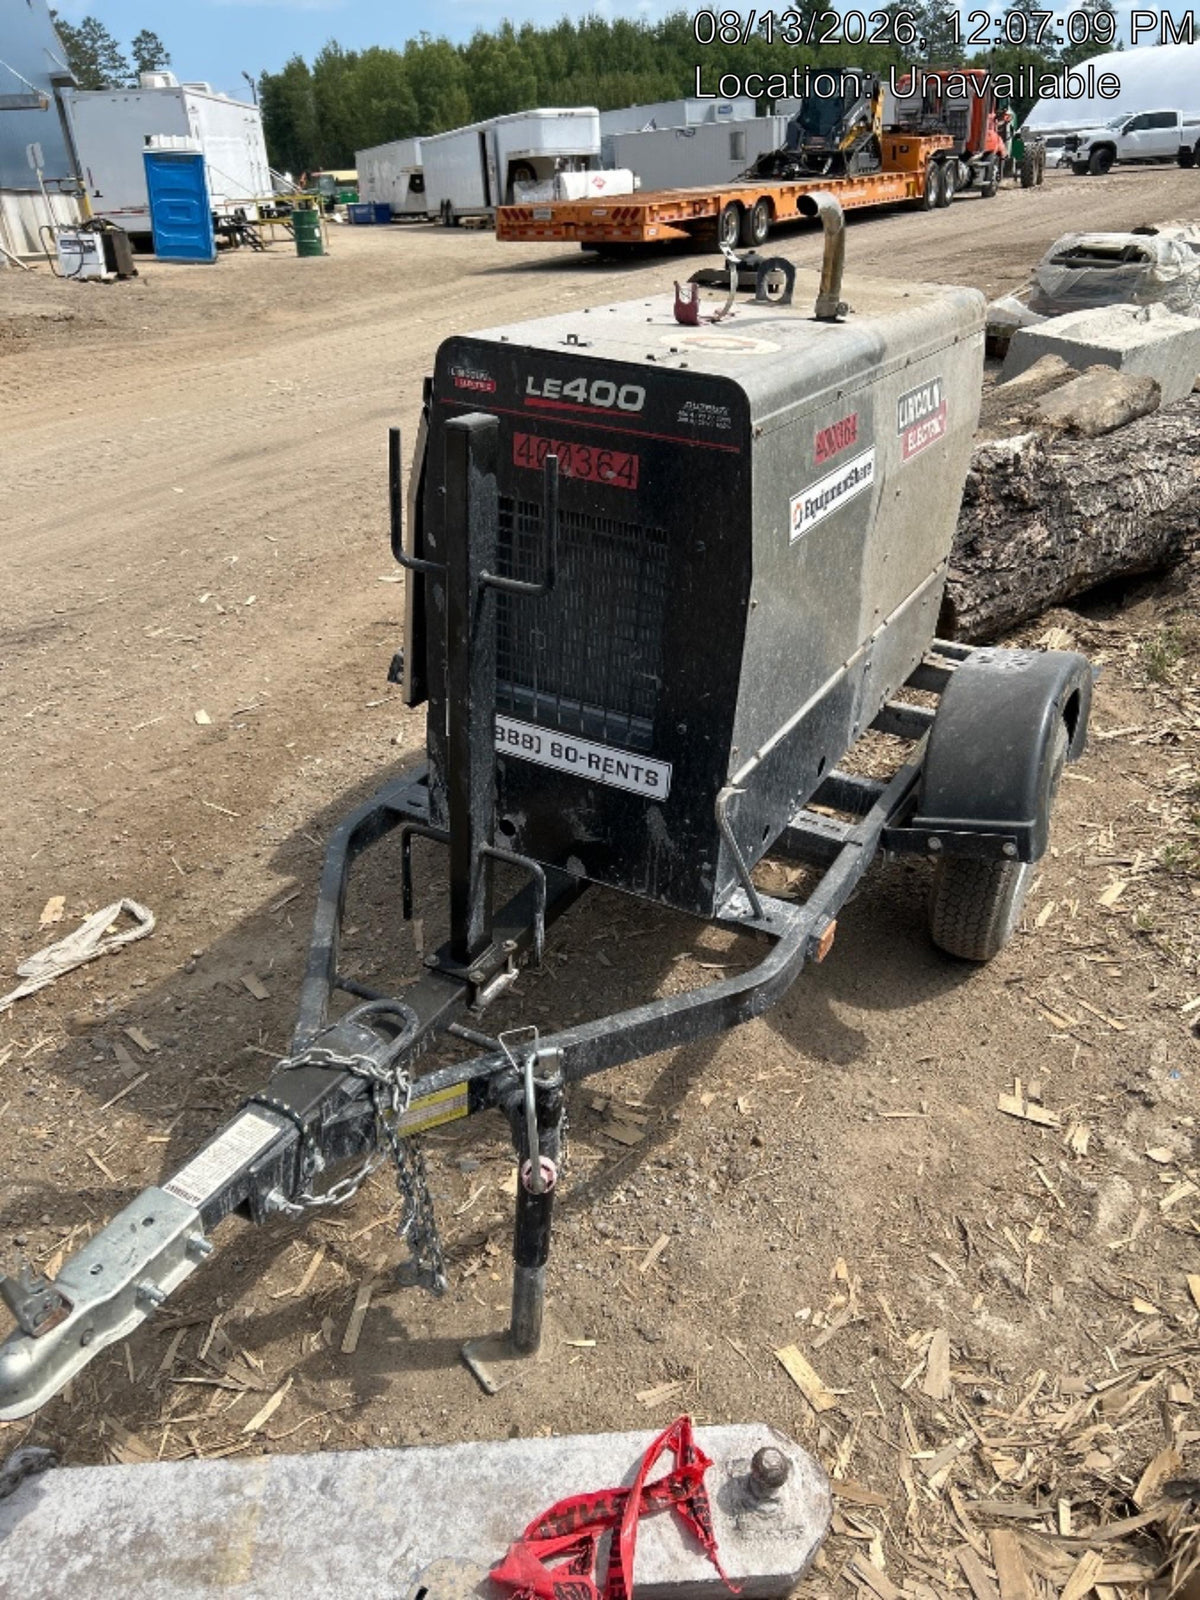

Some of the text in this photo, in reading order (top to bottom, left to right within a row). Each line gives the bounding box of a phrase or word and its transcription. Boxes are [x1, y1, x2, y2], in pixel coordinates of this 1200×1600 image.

[525, 375, 646, 412] LE400
[517, 436, 635, 486] 400364
[804, 461, 872, 519] EquipmentShare
[550, 742, 659, 787] 80-RENTS
